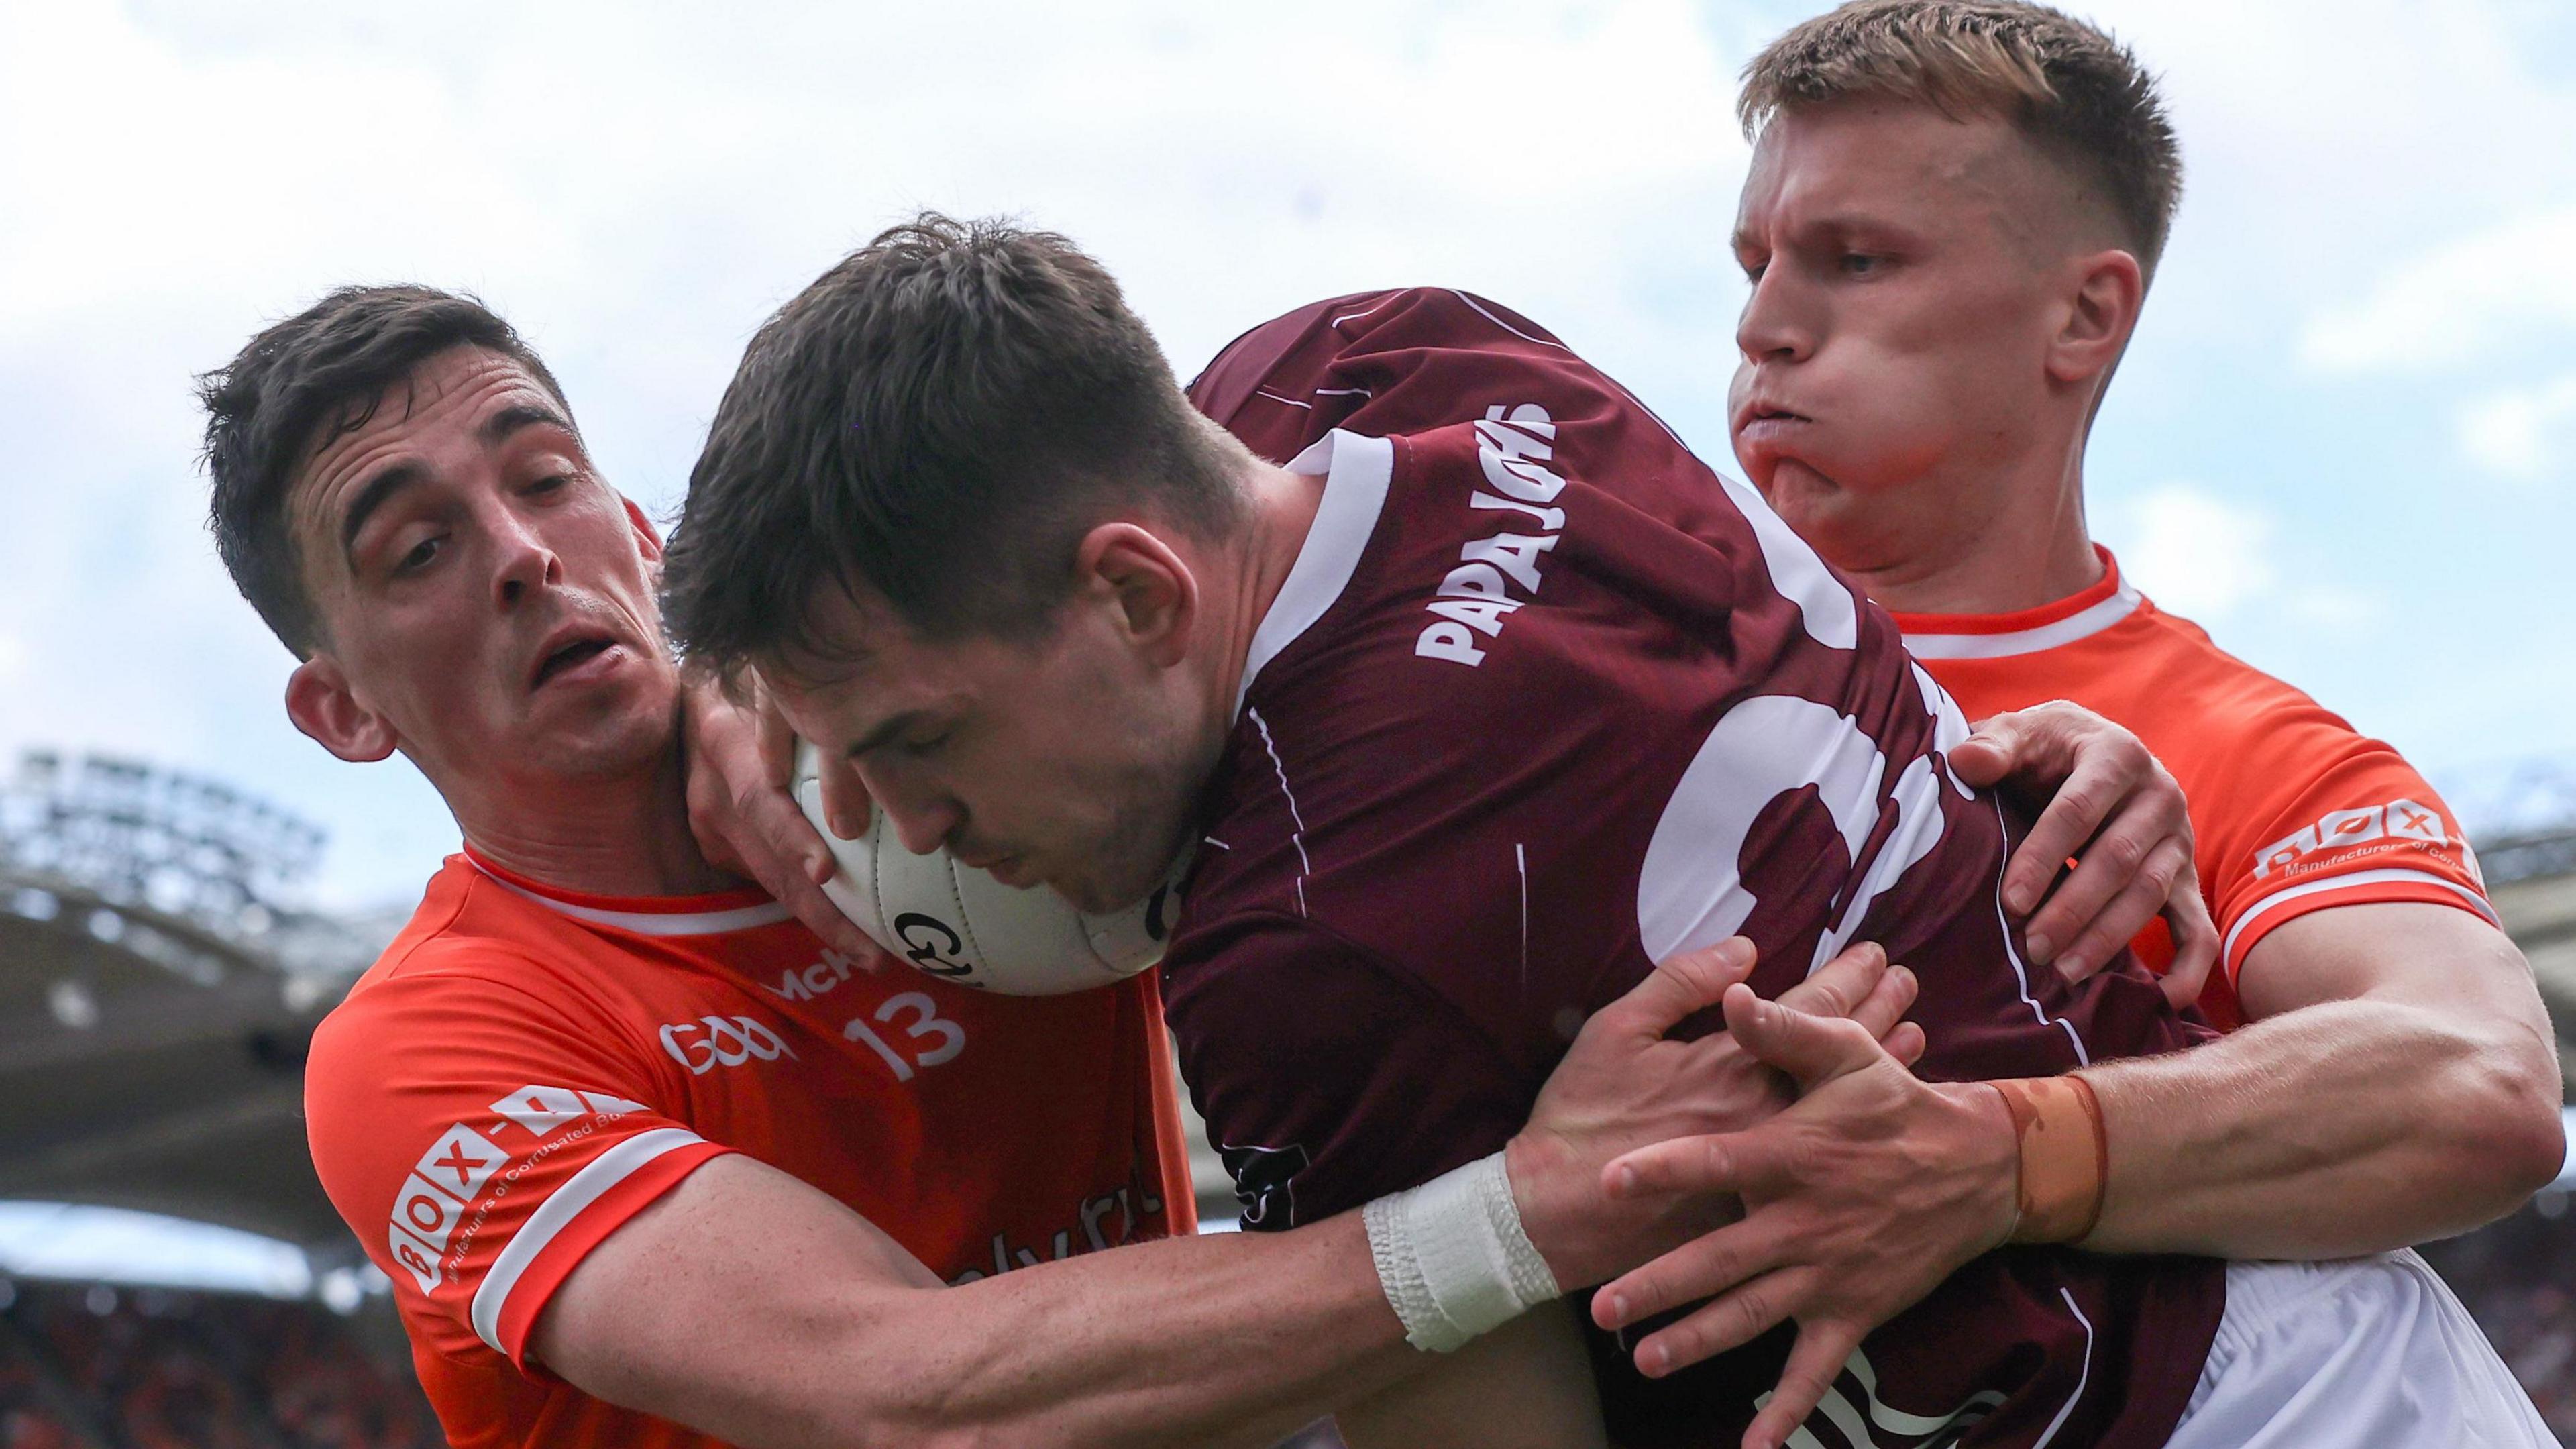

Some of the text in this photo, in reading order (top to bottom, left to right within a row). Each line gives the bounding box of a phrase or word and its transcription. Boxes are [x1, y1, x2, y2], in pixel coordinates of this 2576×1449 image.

[843, 991, 966, 1082] 13
[496, 1178, 510, 1198] of
[505, 1122, 592, 1182] Corrugated
